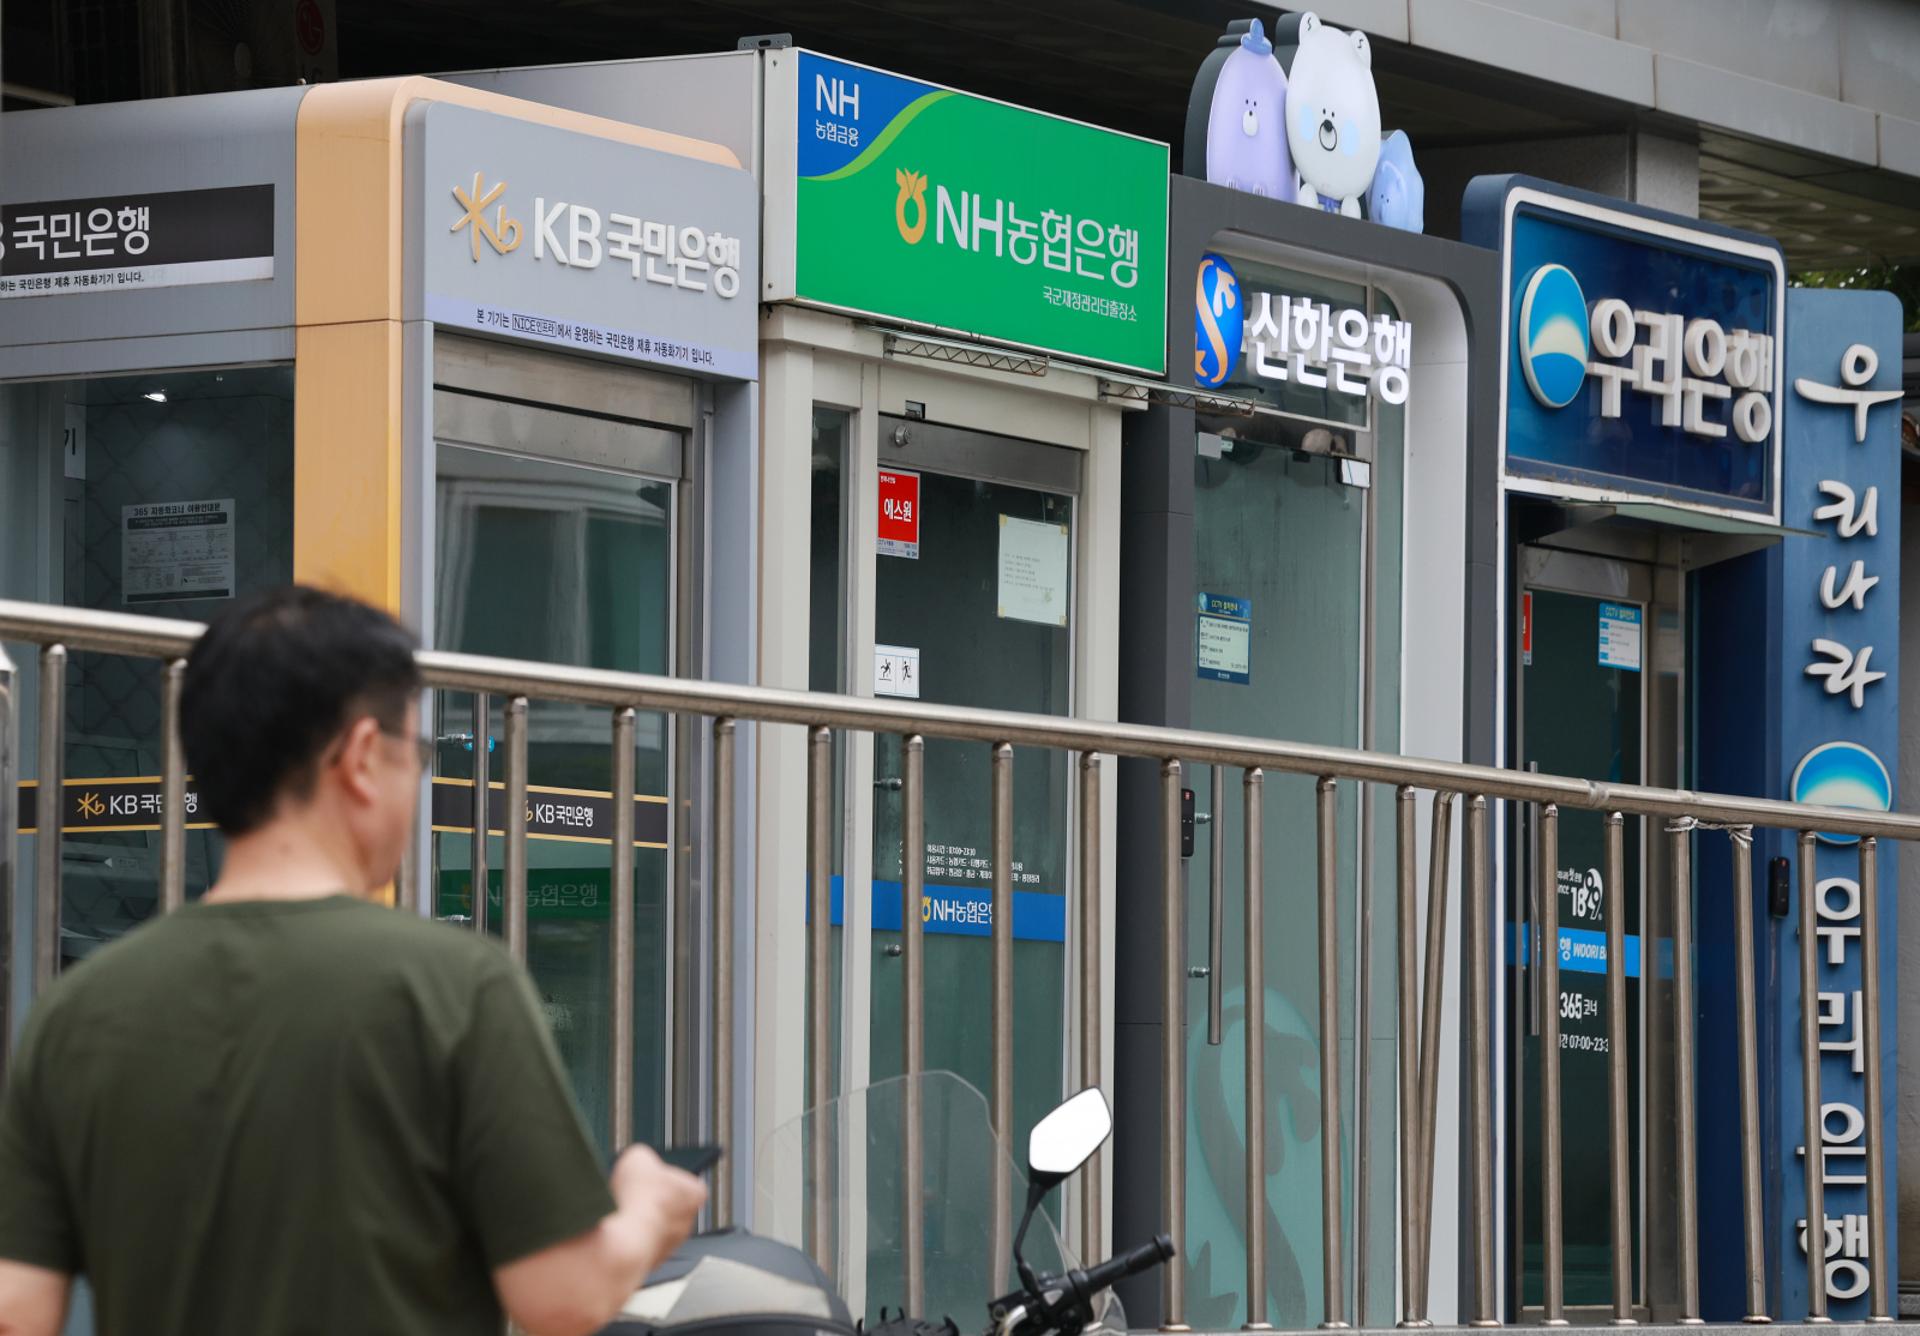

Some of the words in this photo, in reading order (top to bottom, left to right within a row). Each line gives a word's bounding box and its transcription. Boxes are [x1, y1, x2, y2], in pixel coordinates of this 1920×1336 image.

[816, 73, 859, 121] NH
[816, 118, 859, 147] 농협금융
[19, 277, 51, 290] 국민은행
[55, 276, 71, 288] 제휴
[74, 273, 114, 287] 자동화기기
[117, 271, 144, 284] 입니다.
[476, 308, 485, 324] 본
[487, 310, 510, 328] 기기는
[574, 326, 603, 346] 운영하는
[605, 332, 635, 351] 국민은행
[637, 338, 651, 353] 제휴
[653, 341, 689, 362] 자동화기기
[692, 348, 715, 365] 입니다.
[1249, 291, 1412, 405] 신한은행
[1586, 298, 1774, 443] 우리은행
[884, 498, 912, 522] 에스원
[933, 899, 993, 924] NH농협은
[1573, 943, 1598, 960] WOORI
[1560, 992, 1582, 1019] 365
[1583, 998, 1598, 1016] 코너
